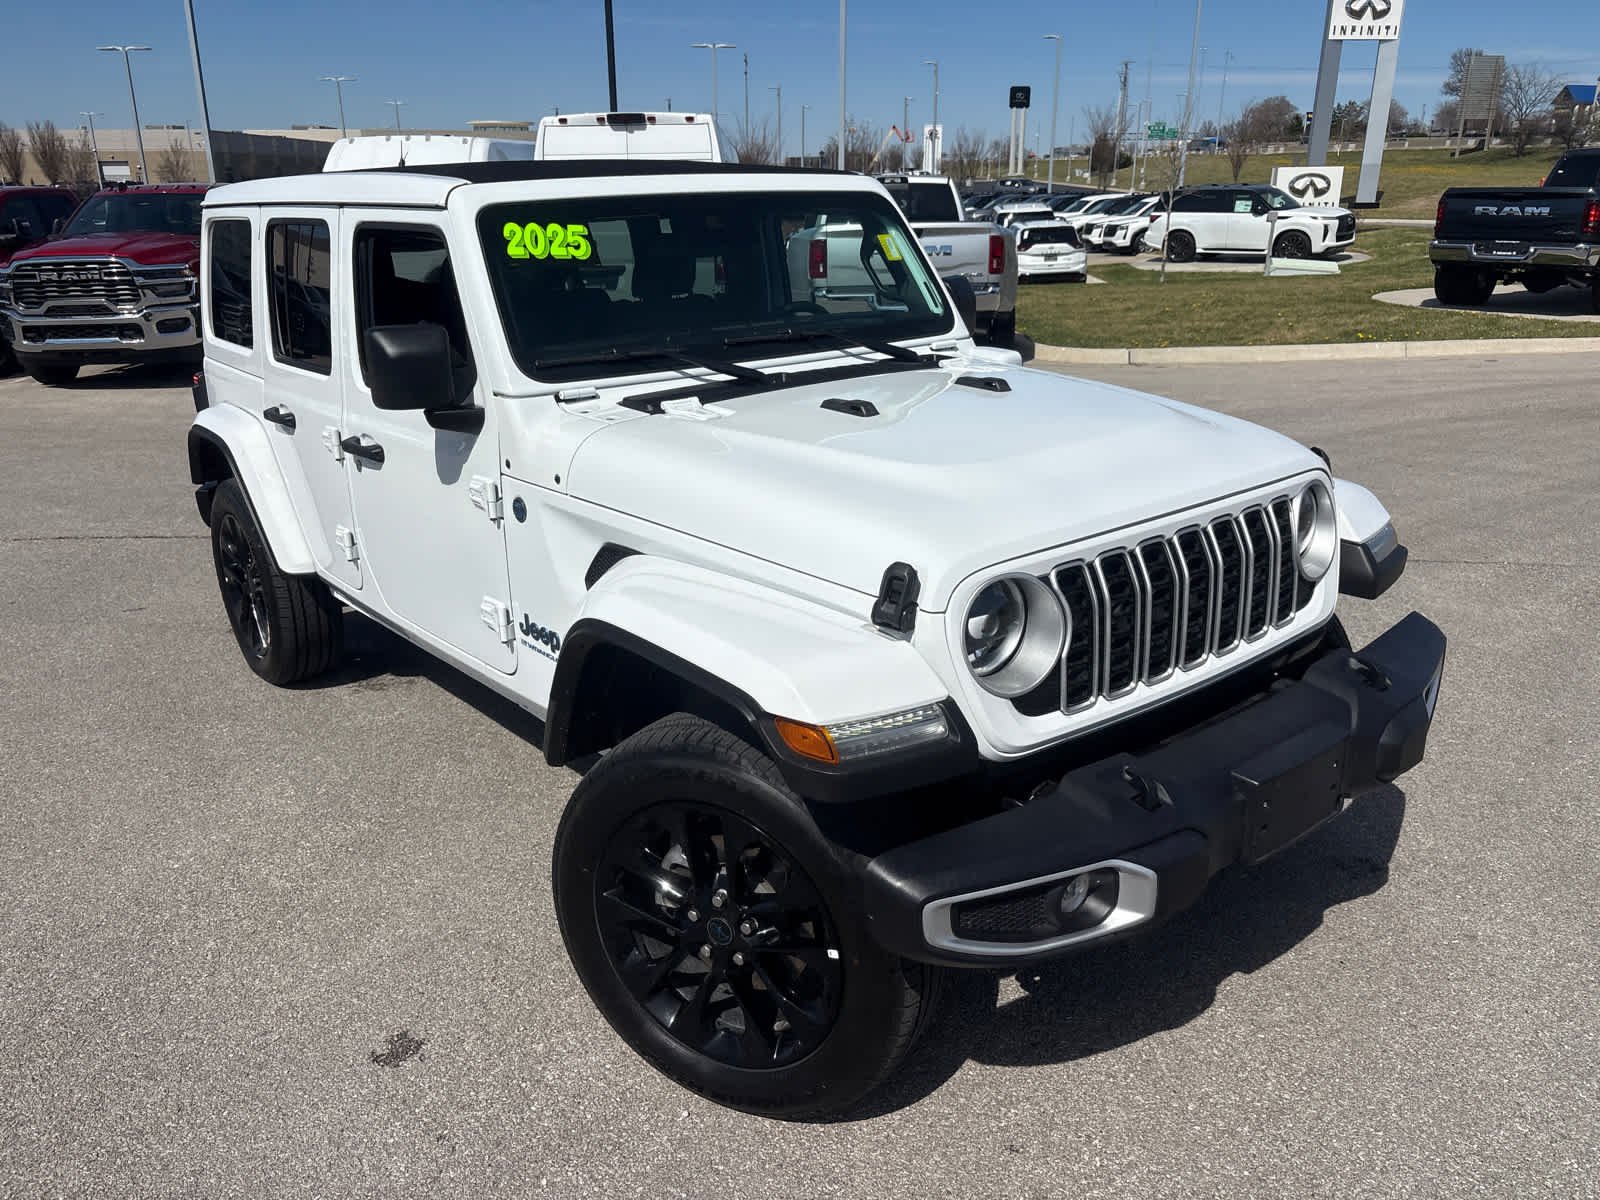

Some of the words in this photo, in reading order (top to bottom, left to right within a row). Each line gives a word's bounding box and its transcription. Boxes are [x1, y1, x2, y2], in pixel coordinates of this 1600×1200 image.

[1332, 25, 1398, 36] INFINITI
[1474, 206, 1552, 217] RAM
[503, 222, 592, 260] 2025
[38, 271, 101, 281] RAM
[519, 612, 561, 654] Jeep
